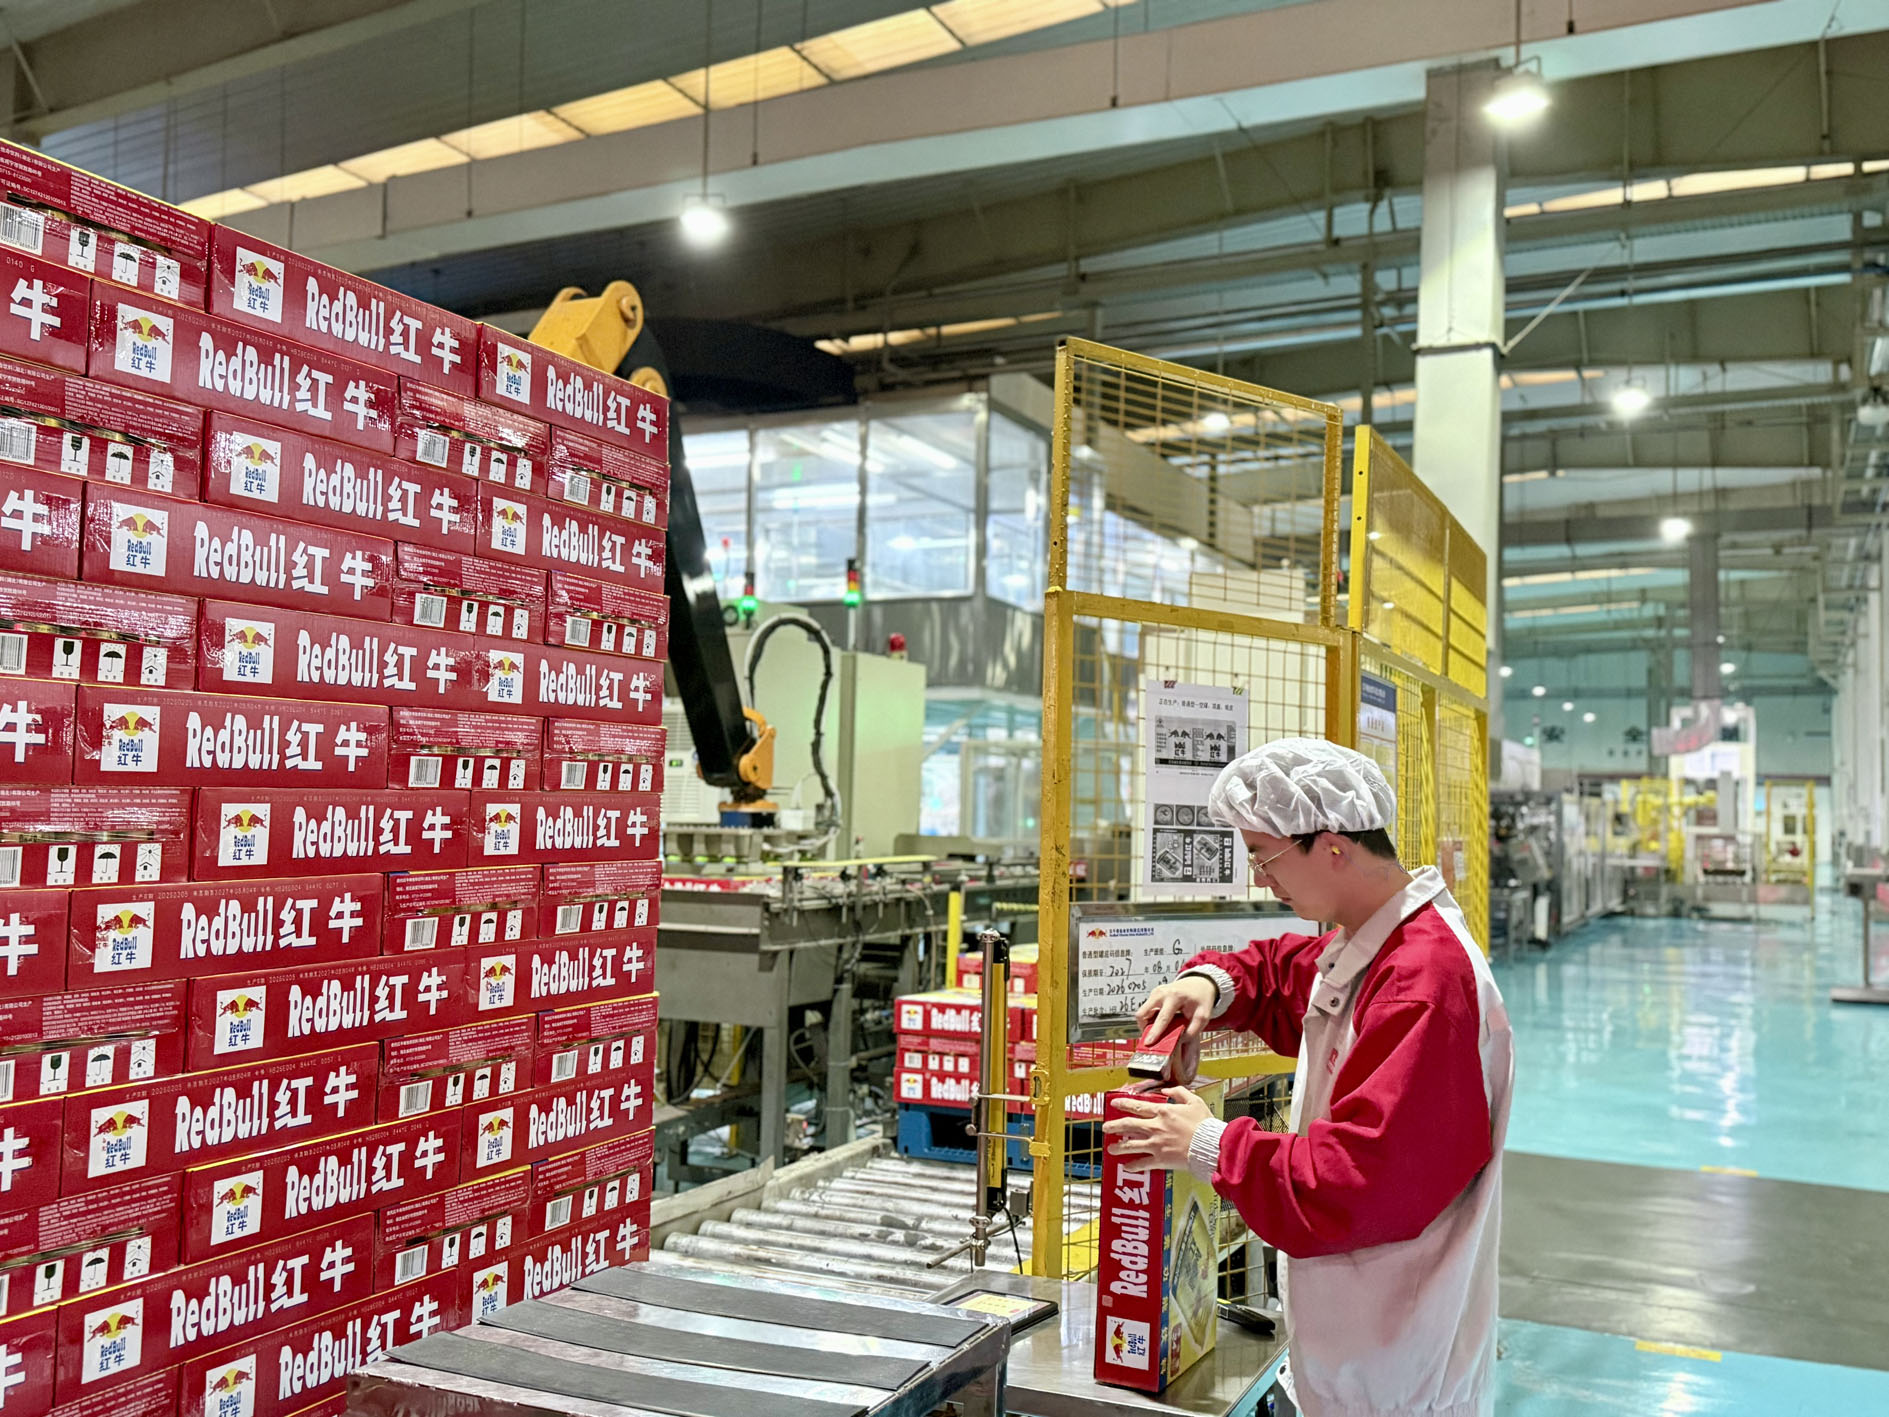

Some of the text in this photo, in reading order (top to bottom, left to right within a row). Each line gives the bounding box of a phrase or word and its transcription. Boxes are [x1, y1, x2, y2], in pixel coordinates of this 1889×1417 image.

[247, 281, 270, 301] RedBull
[9, 278, 61, 341] 牛
[247, 296, 269, 312] 红牛
[305, 276, 461, 375] RedBull 红牛
[132, 341, 157, 360] RedBull
[130, 355, 155, 372] 红牛
[198, 331, 291, 410] RedBull
[294, 363, 378, 431] 红牛
[546, 364, 604, 427] RedBull
[606, 390, 658, 444] 红牛
[245, 466, 267, 482] RedBull
[243, 479, 265, 494] 红牛
[302, 452, 461, 535] RedBull 红牛
[0, 489, 53, 551] 牛
[127, 538, 152, 555] RedBull
[541, 512, 599, 568] RedBull
[601, 530, 663, 578] 红牛
[125, 553, 150, 568] 红牛
[193, 520, 287, 589] RedBull
[290, 540, 375, 601] 红牛
[238, 651, 260, 665] RedBull
[296, 629, 458, 694] RedBull 红牛
[237, 664, 259, 677] 红牛
[538, 658, 652, 712] RedBull 红牛
[0, 700, 46, 763] 牛
[185, 711, 280, 770] RedBull
[284, 719, 370, 772] 红牛
[118, 738, 143, 753] RedBull
[117, 753, 142, 766] 红牛
[292, 804, 453, 859] RedBull 红牛
[535, 805, 649, 850] RedBull 红牛
[233, 834, 256, 848] RedBull
[232, 847, 255, 861] 红牛
[179, 895, 274, 959] RedBull
[278, 892, 364, 949] 红牛
[112, 936, 137, 952] RedBull
[1172, 939, 1183, 956] G
[111, 951, 136, 966] 红牛
[1109, 958, 1132, 980] 2027
[530, 942, 645, 998] RedBull 红牛
[287, 966, 449, 1038] RedBull 红牛
[229, 1019, 252, 1034] RedBull
[228, 1032, 250, 1047] 红牛
[174, 1065, 359, 1154] RedBull 红牛
[528, 1078, 643, 1149] RedBull 红牛
[106, 1136, 132, 1154] RedBull
[105, 1152, 130, 1168] 红牛
[284, 1146, 367, 1219] RedBull
[370, 1130, 445, 1194] 红牛
[226, 1205, 248, 1222] RedBull
[225, 1219, 247, 1236] 红牛
[523, 1217, 639, 1300] RedBull 红牛
[1109, 1207, 1150, 1299] RedBull
[169, 1239, 355, 1348] RedBull 红牛
[100, 1337, 126, 1358] RedBull
[278, 1294, 441, 1400] RedBull 红牛
[99, 1352, 125, 1372] 红牛
[219, 1391, 242, 1411] RedBull
